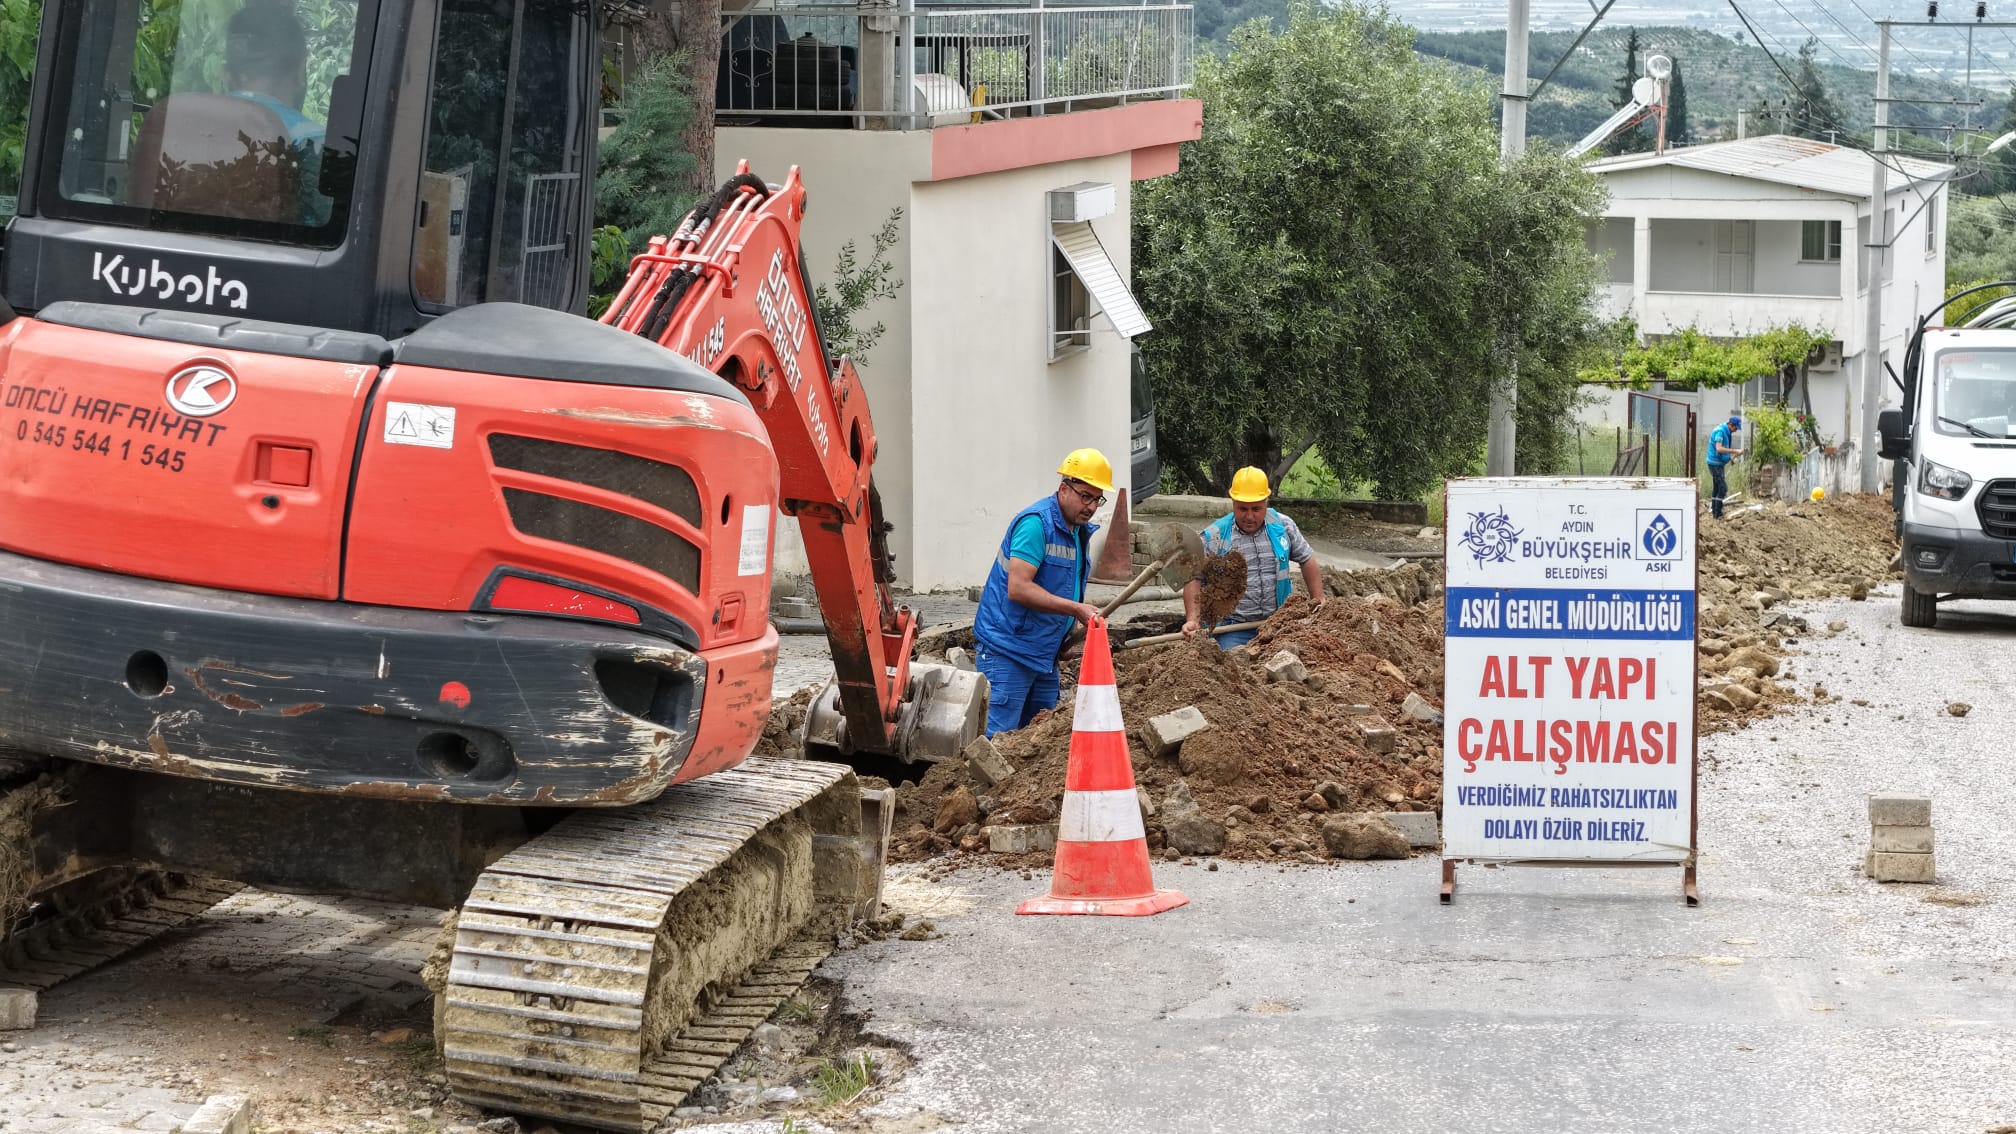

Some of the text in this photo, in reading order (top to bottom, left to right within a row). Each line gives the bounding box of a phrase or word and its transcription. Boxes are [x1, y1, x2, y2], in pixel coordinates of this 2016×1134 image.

[92, 251, 249, 310] Kubota
[767, 247, 807, 353] ÖNCÜ
[708, 315, 725, 364] 545
[71, 395, 227, 447] HAFRİYAT
[17, 419, 187, 473] 0 545 544 1 545
[1561, 521, 1594, 533] AYDIN
[1568, 504, 1587, 515] T.C.
[1522, 537, 1632, 563] BÜYÜKŞEHİR
[1645, 561, 1671, 572] ASKİ
[1545, 565, 1608, 580] BELEDİYESİ
[1459, 592, 1682, 632] ASKİ GENEL MÜDÜRLÜĞÜ
[1479, 655, 1656, 701] ALT YAPI
[1457, 717, 1678, 775] ÇALIŞMASI
[1457, 783, 1677, 809] VERDİĞİMİZ RAHATSIZLIKTAN
[1484, 817, 1649, 842] DOLAYI ÖZÜR DİLERİZ.
